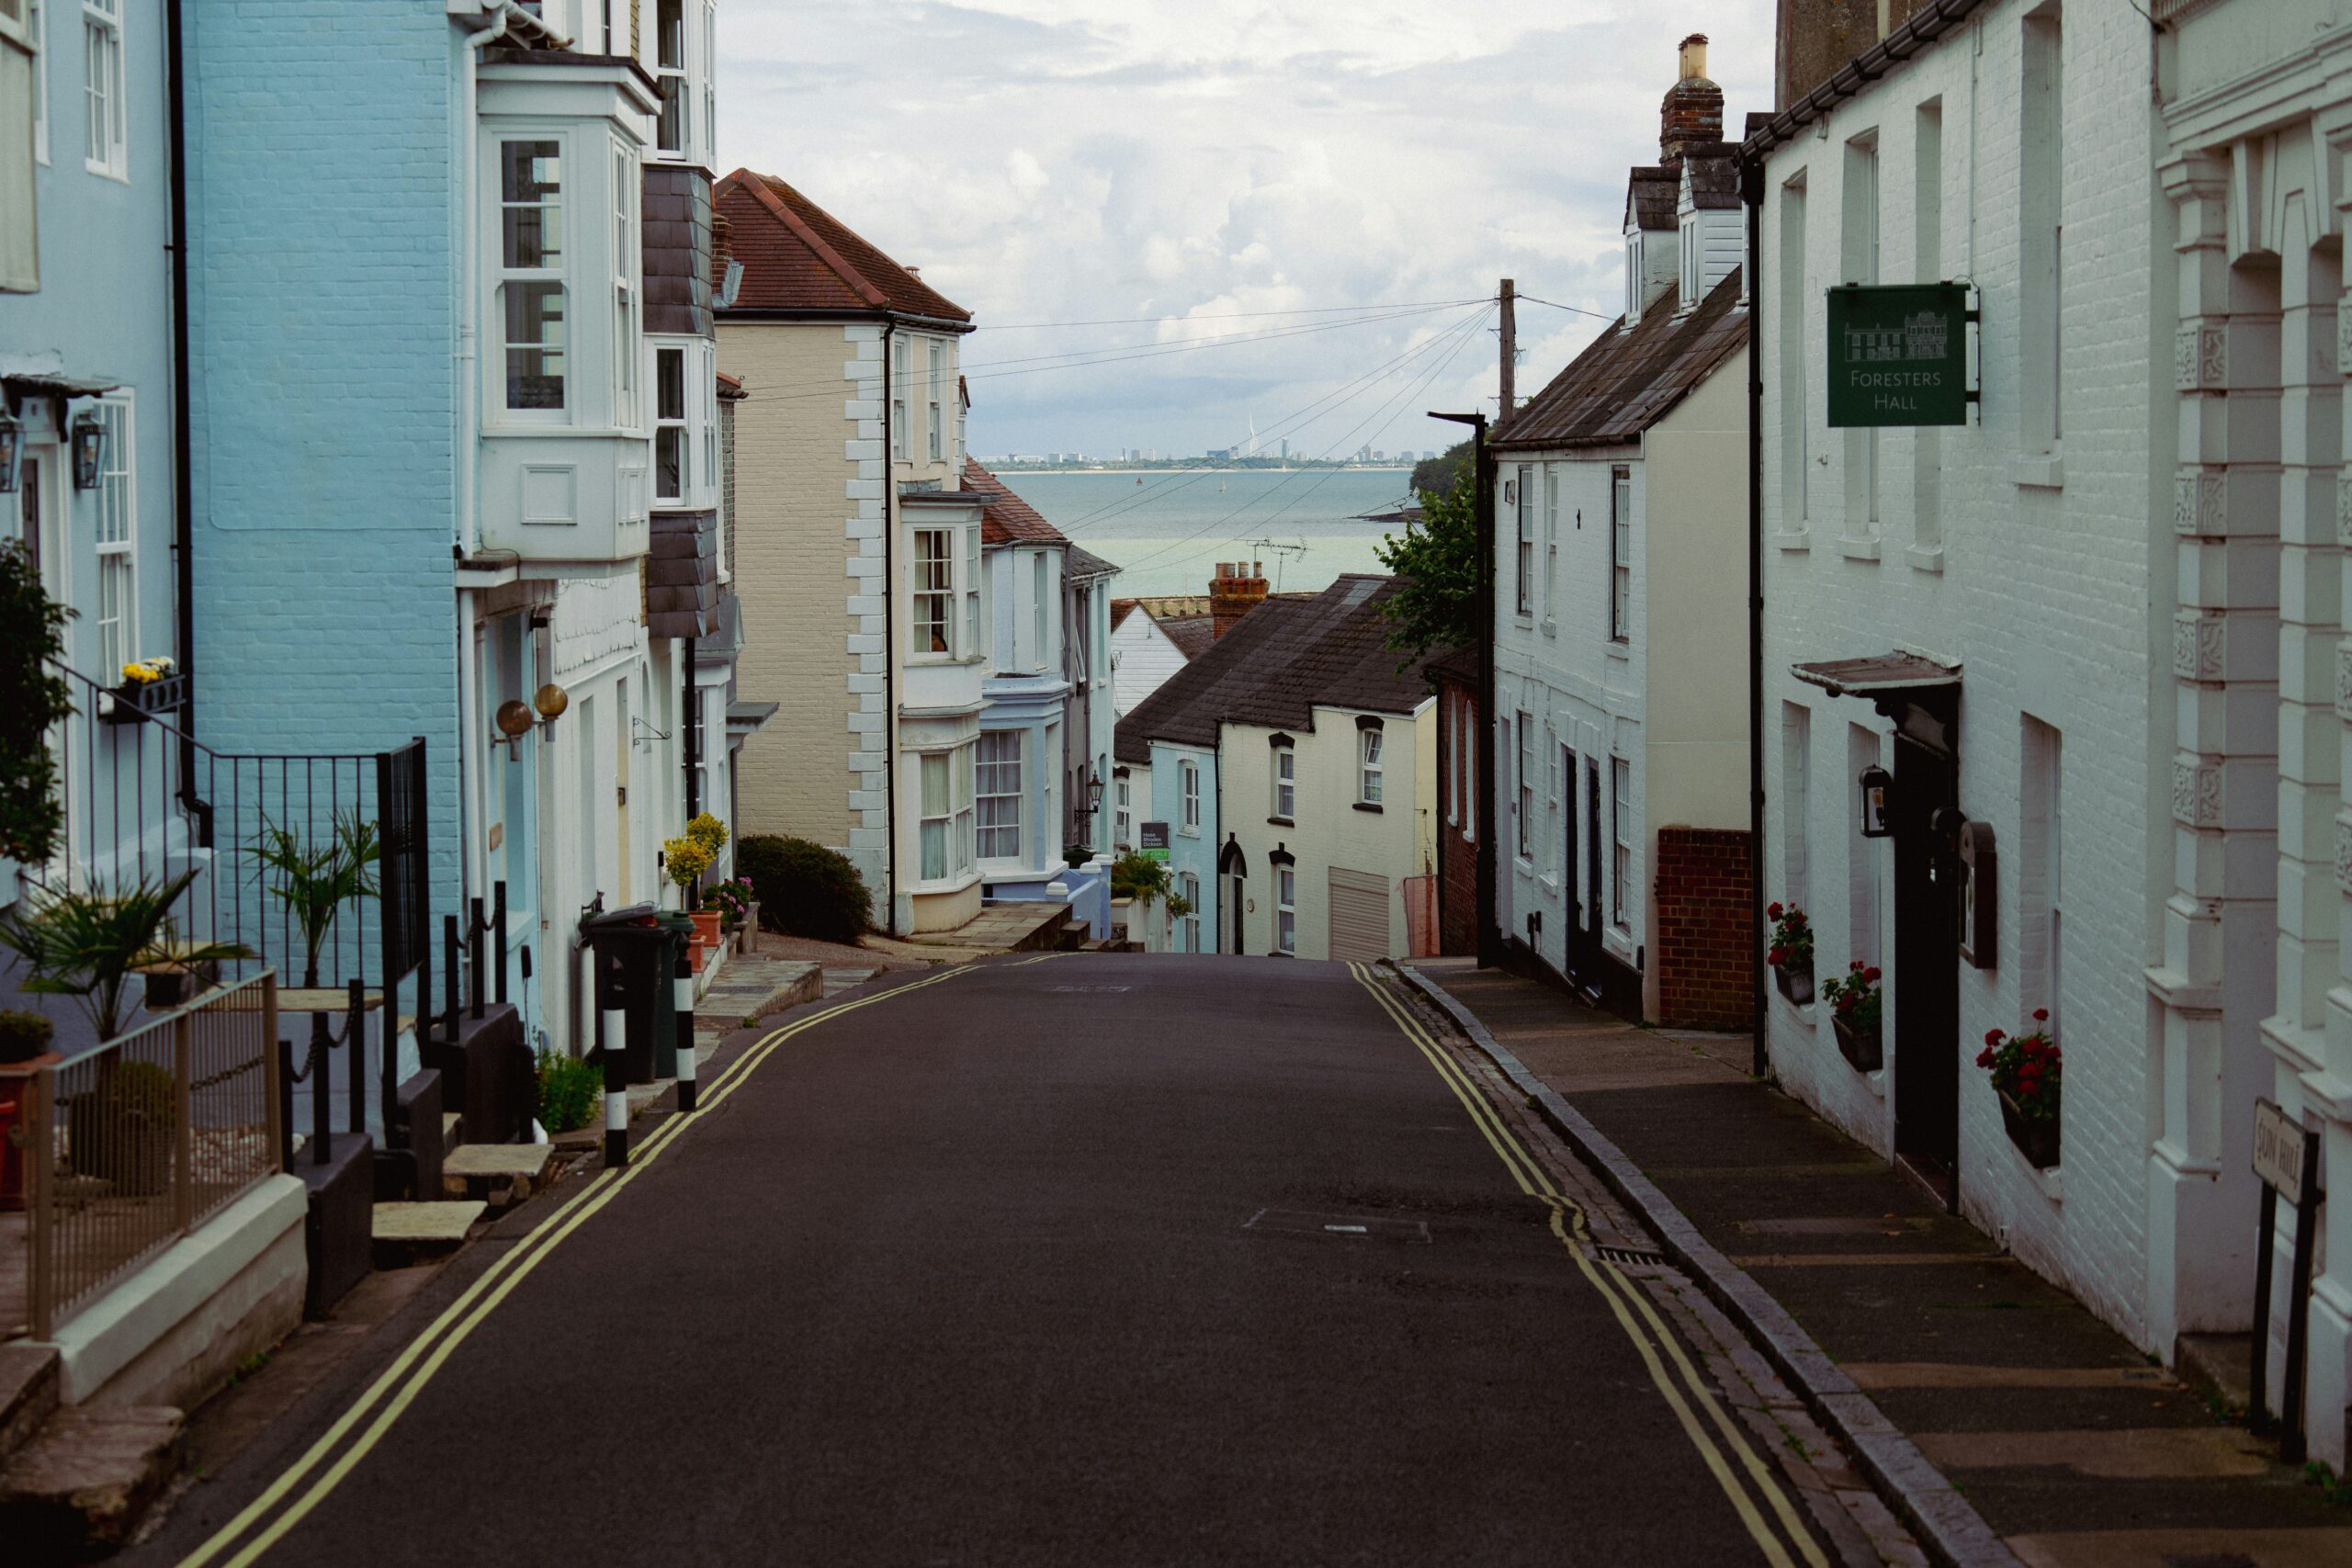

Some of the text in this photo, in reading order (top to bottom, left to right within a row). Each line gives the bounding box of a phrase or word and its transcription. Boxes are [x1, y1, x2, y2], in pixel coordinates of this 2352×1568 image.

[1851, 370, 1941, 387] FORESTERS
[1874, 393, 1917, 410] HALL
[2257, 1122, 2299, 1180] SUN HILL
